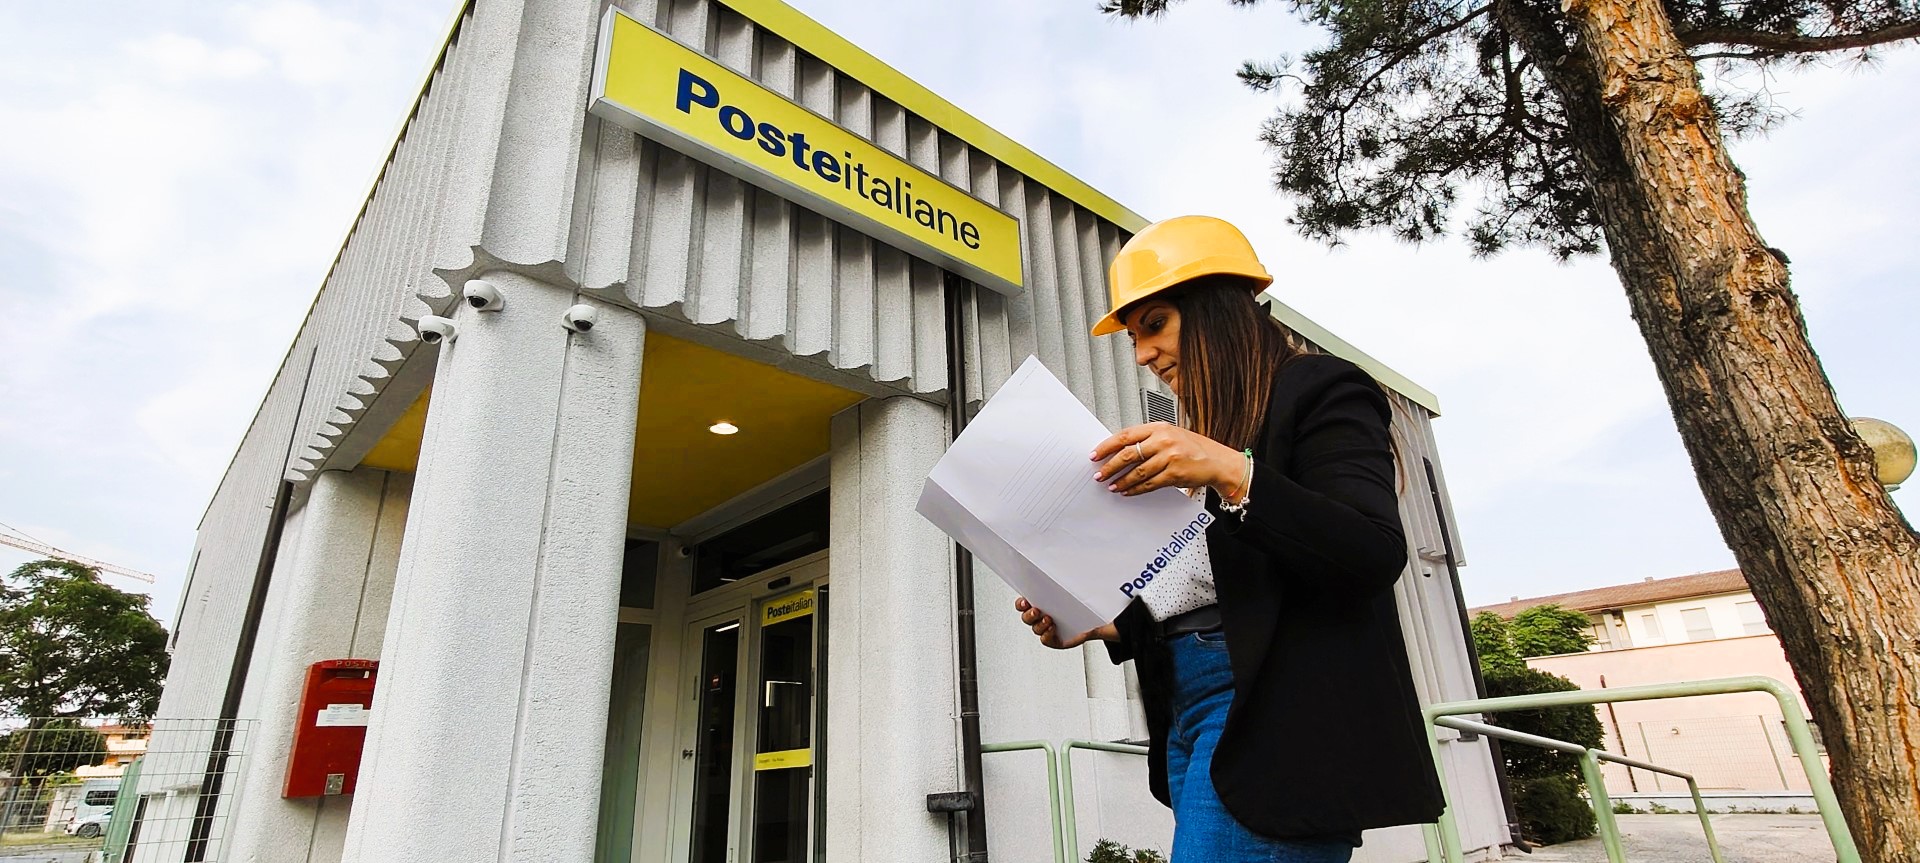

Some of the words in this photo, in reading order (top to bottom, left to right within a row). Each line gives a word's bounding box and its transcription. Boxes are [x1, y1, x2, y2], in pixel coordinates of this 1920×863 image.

[675, 68, 980, 250] Posteitaliane
[1119, 512, 1211, 599] Posteitaliane
[767, 598, 813, 619] Posteitalian
